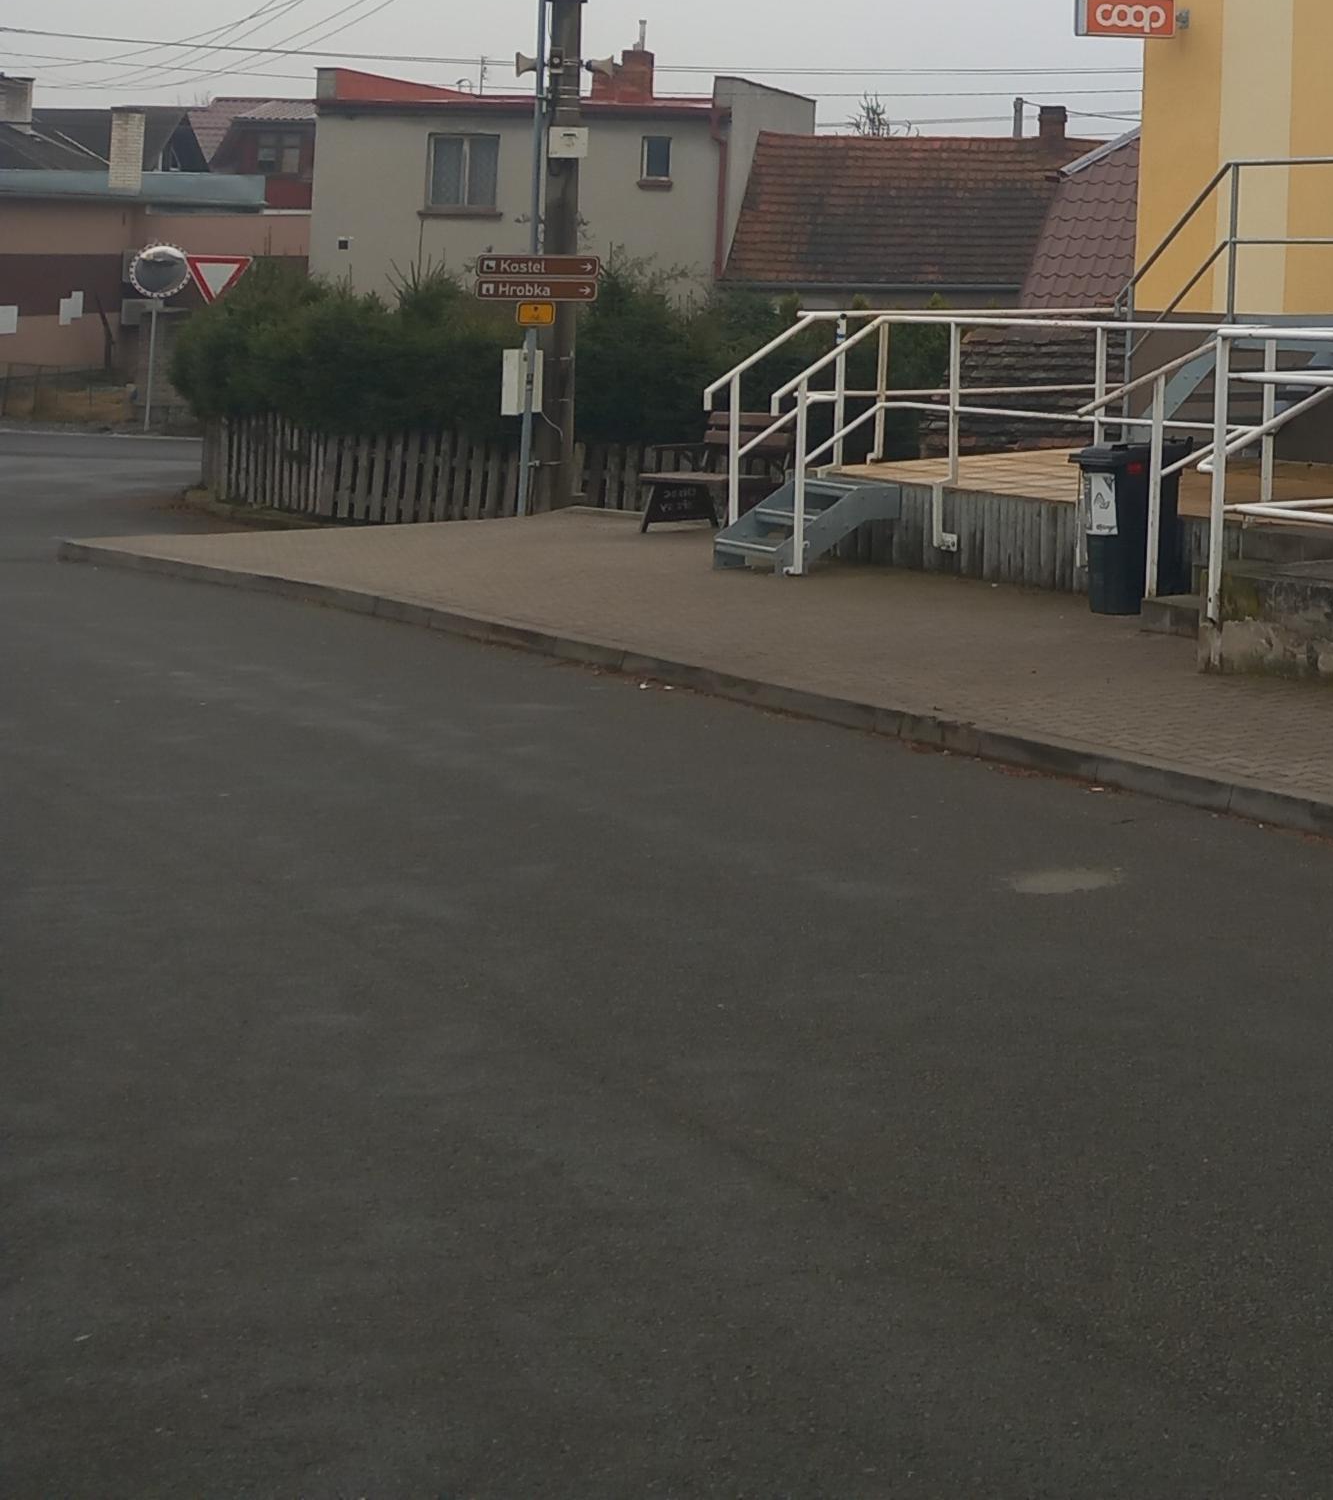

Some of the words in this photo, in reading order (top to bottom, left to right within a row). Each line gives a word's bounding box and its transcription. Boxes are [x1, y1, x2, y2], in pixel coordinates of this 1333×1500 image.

[1096, 3, 1166, 33] coop
[500, 259, 546, 273] Kostel
[499, 283, 551, 297] Hrobka
